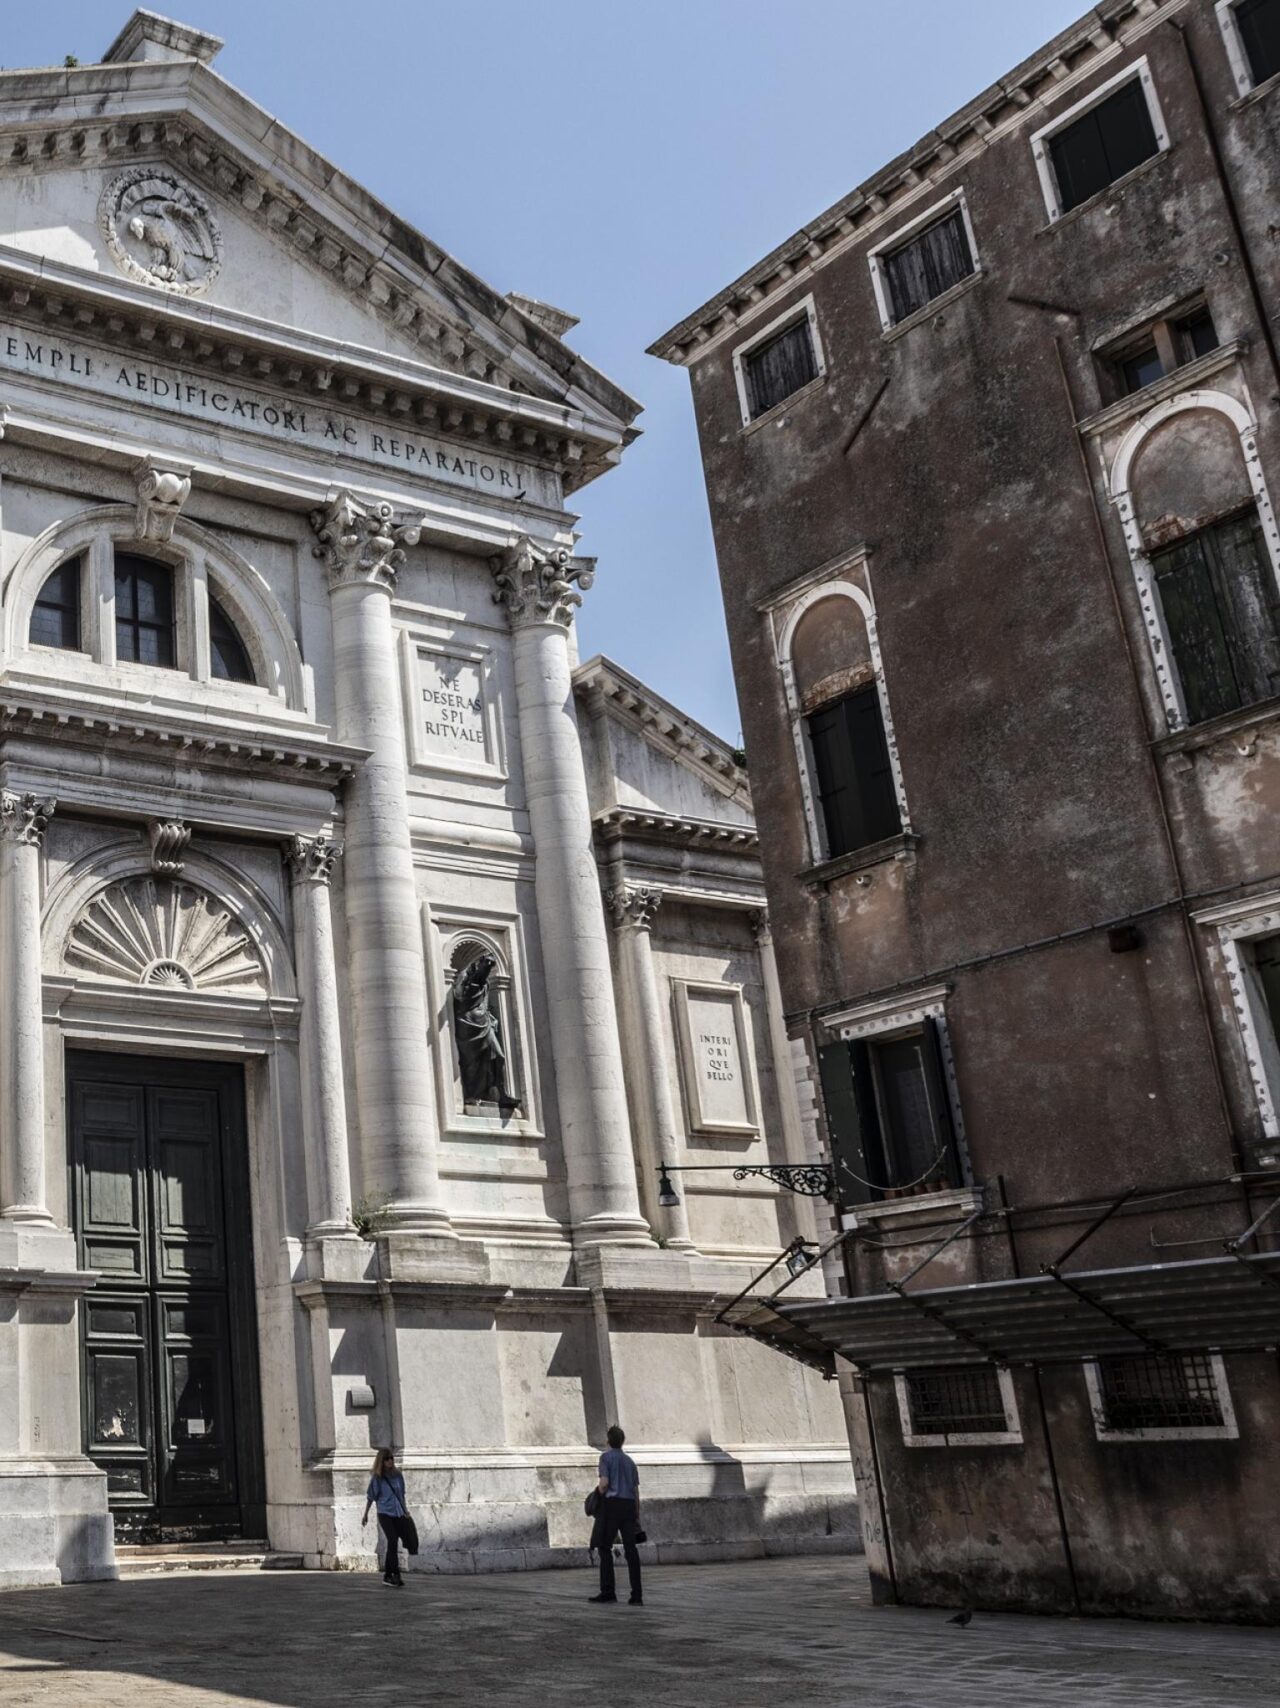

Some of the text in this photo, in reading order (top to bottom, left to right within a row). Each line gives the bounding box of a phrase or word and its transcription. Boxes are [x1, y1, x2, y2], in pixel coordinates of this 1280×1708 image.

[116, 368, 308, 434] AEDIFICATORI
[324, 420, 358, 446] AC
[372, 433, 522, 491] REPARATORI
[439, 676, 460, 692] NE
[422, 688, 482, 712] DESERAS
[441, 708, 464, 724] SPI
[425, 721, 485, 744] RITVALE
[700, 1034, 732, 1046] INTERI
[707, 1047, 728, 1057] ORI
[709, 1059, 729, 1071] QVE
[706, 1071, 734, 1081] BELLO
